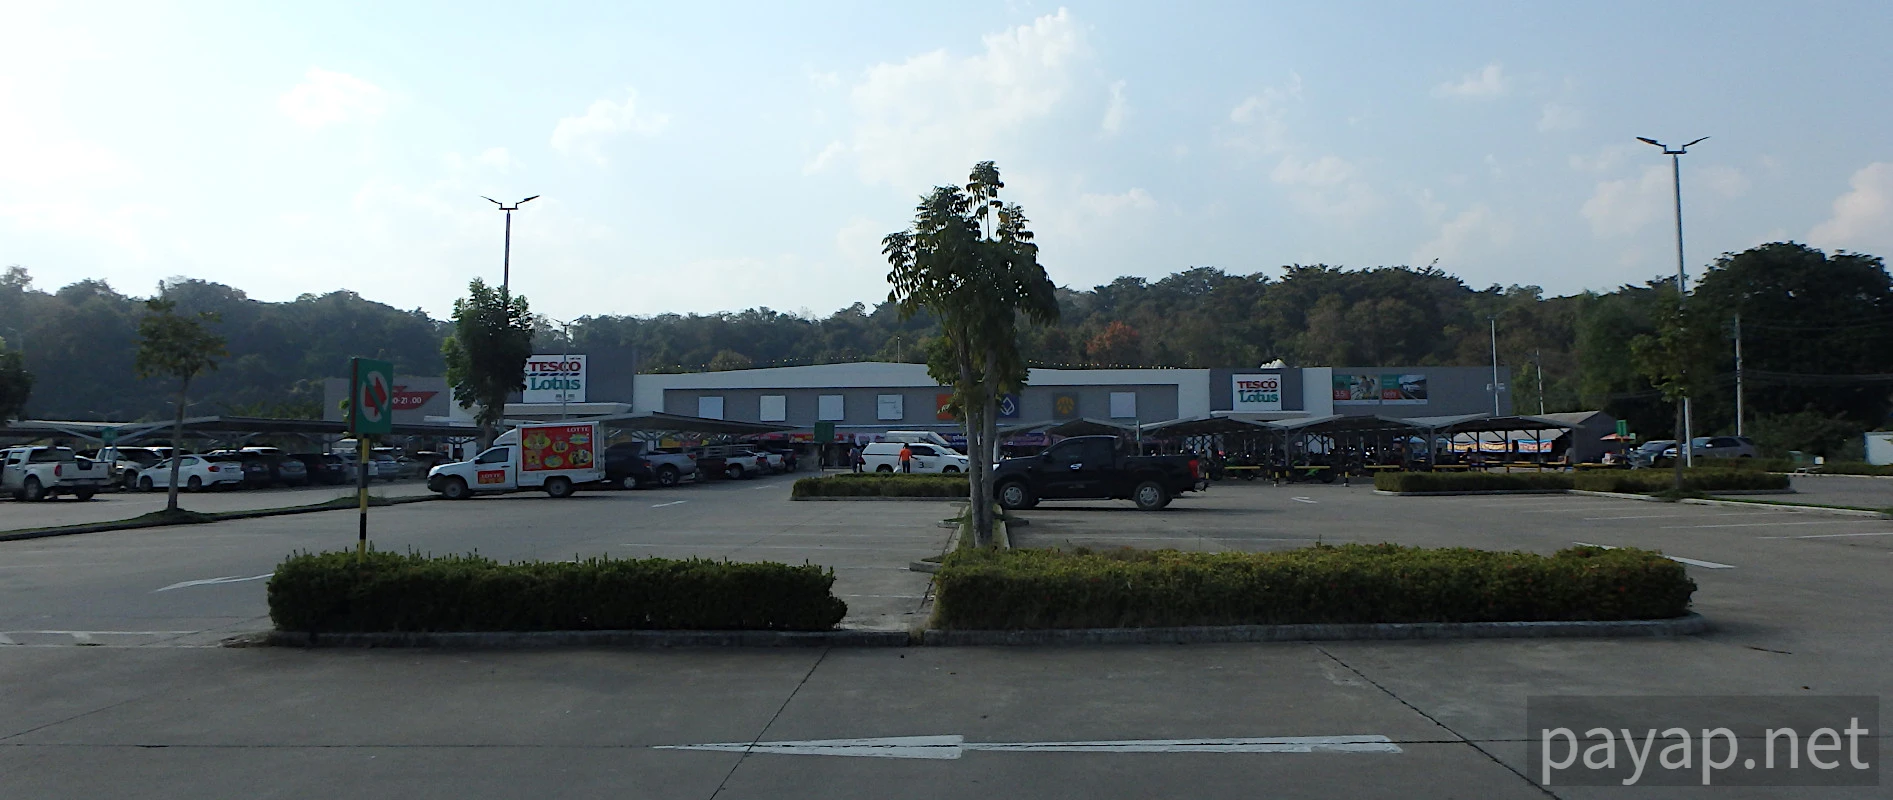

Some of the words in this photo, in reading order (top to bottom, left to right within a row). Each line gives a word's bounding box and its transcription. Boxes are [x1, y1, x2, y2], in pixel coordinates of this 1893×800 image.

[528, 361, 581, 372] TESCO
[530, 377, 581, 390] Lotus
[1236, 380, 1278, 389] TESCO
[1239, 390, 1278, 402] Lotus
